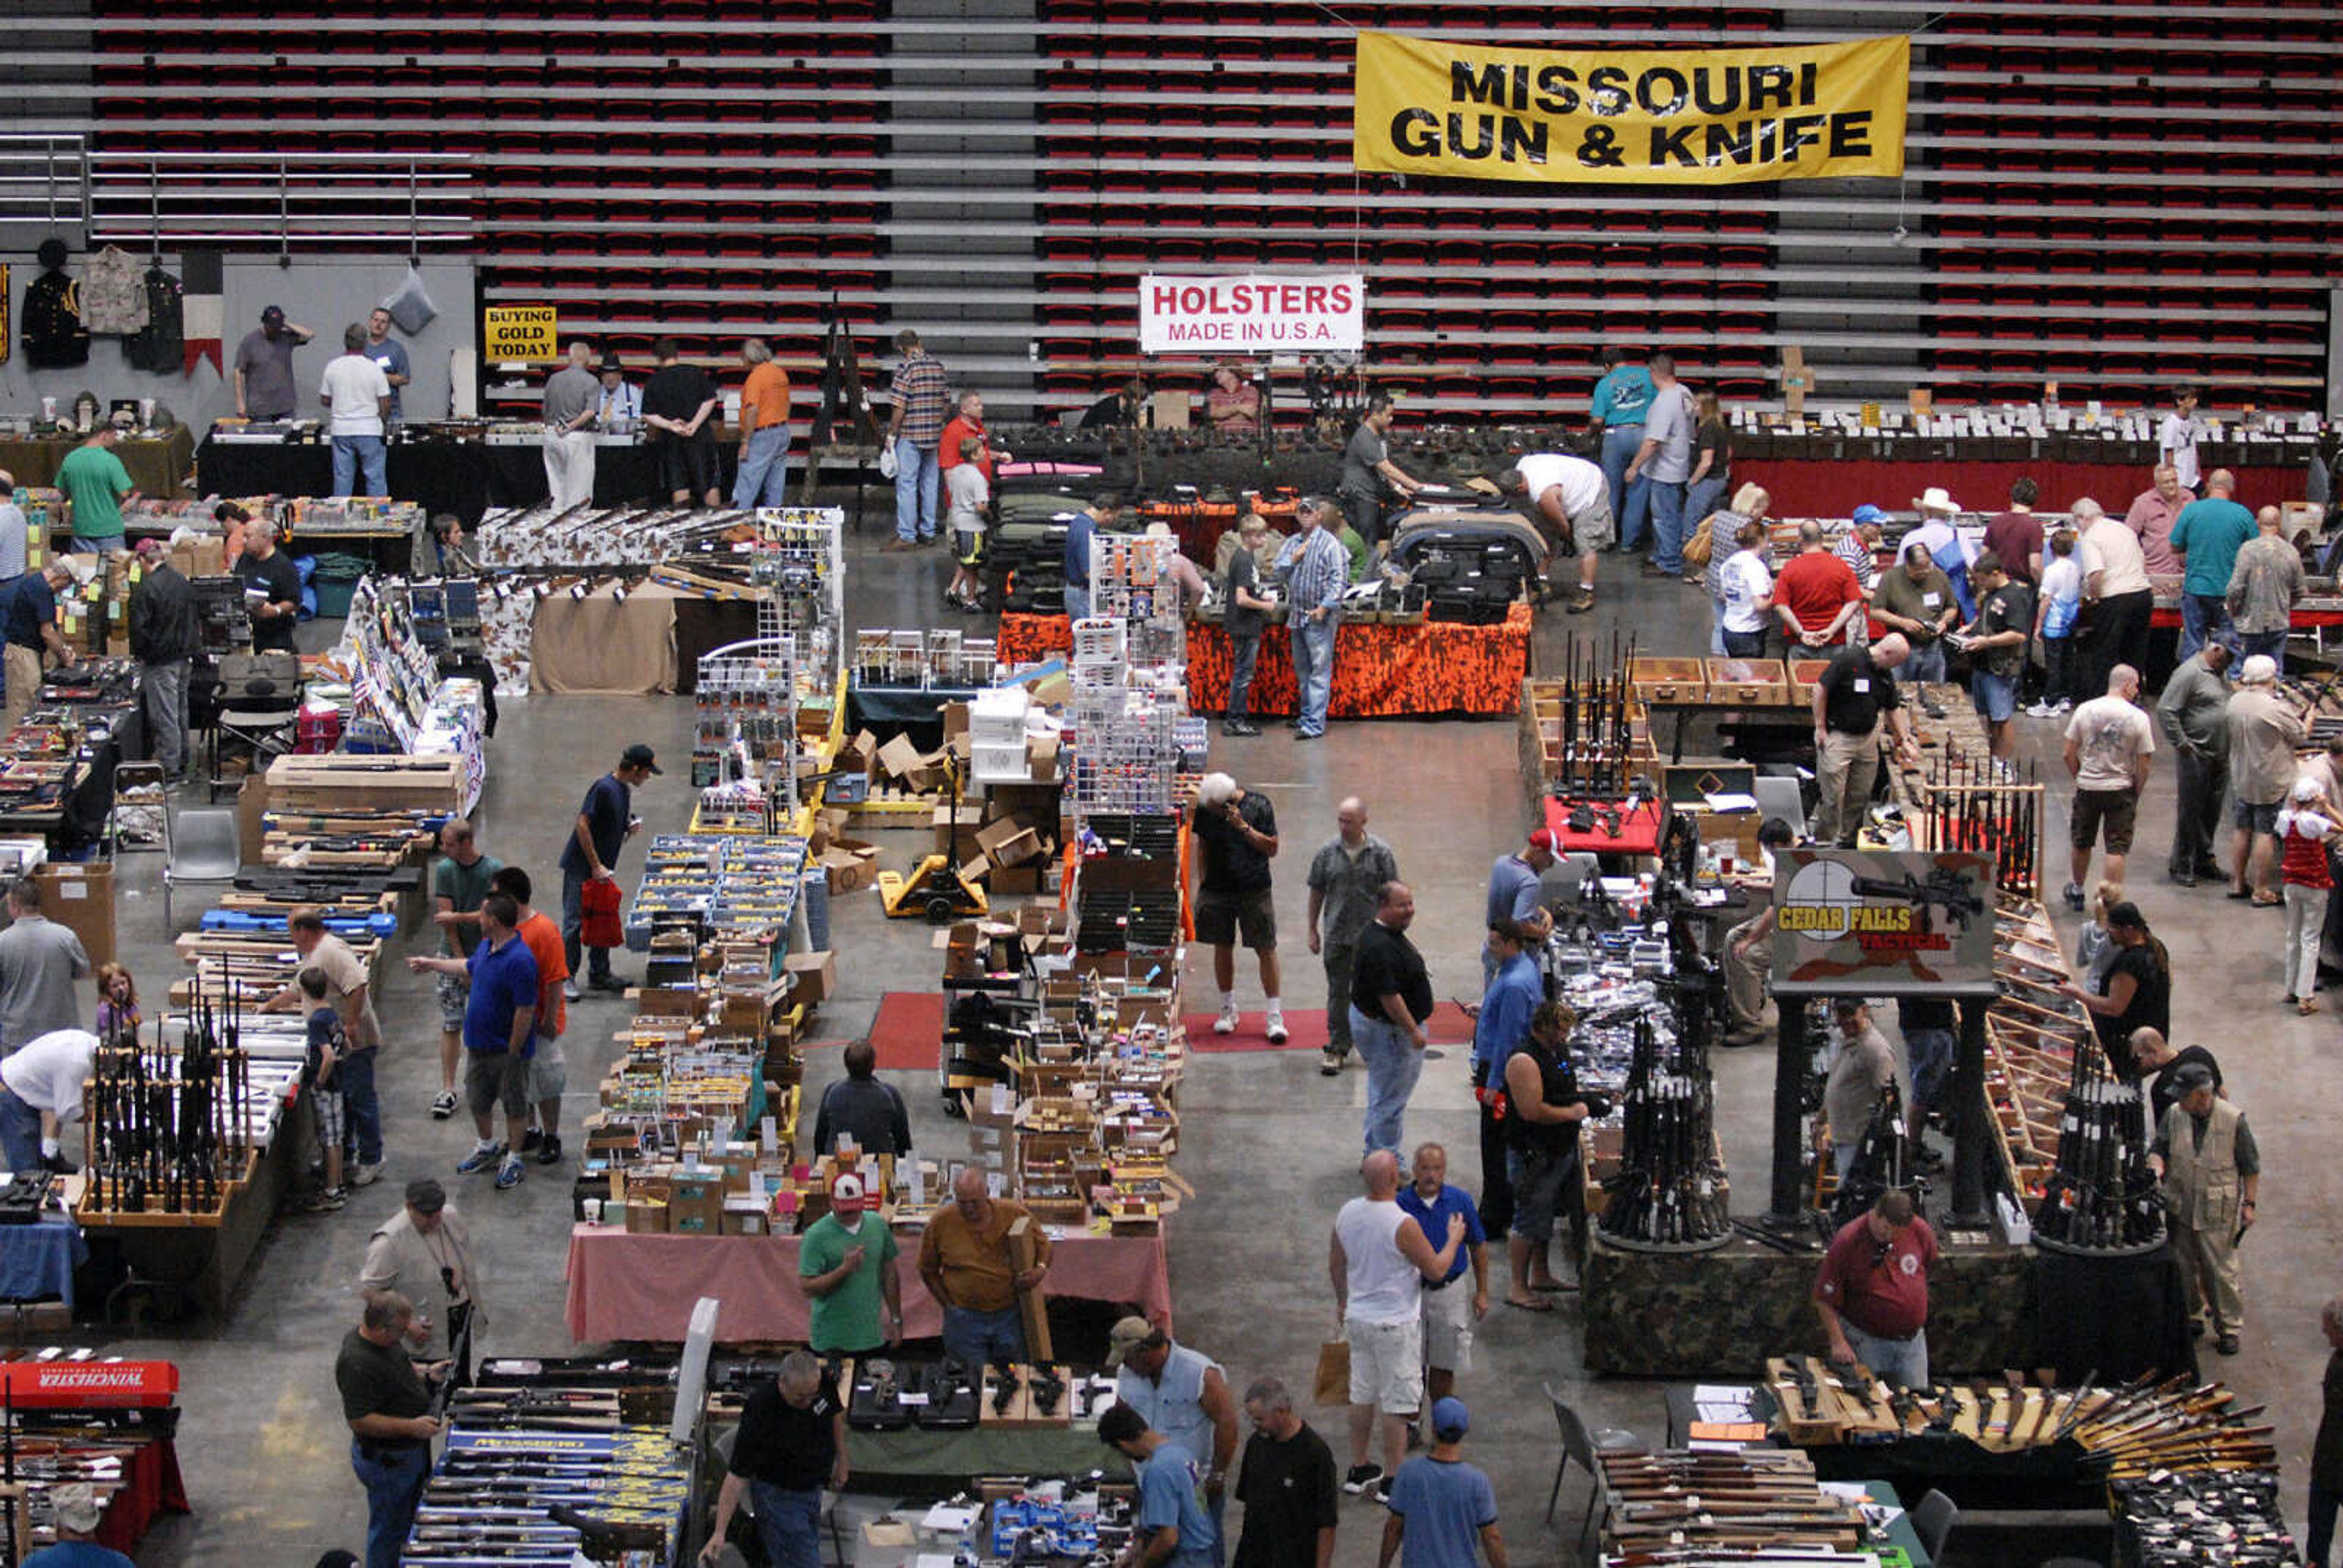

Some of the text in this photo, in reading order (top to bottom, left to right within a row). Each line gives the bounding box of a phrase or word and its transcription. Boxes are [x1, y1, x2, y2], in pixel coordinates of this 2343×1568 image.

[1450, 60, 1816, 118] MISSOURI
[1391, 107, 1873, 168] GUN & KNIFE
[1153, 285, 1353, 315] HOLSTERS
[490, 311, 552, 322] BUYING
[498, 327, 544, 339] GOLD
[1168, 322, 1337, 340] MADE IN U.S.A.
[492, 344, 551, 355] TODAY
[1778, 906, 1911, 932] CEDAR FALLS
[40, 1373, 143, 1387] WINCHESTER
